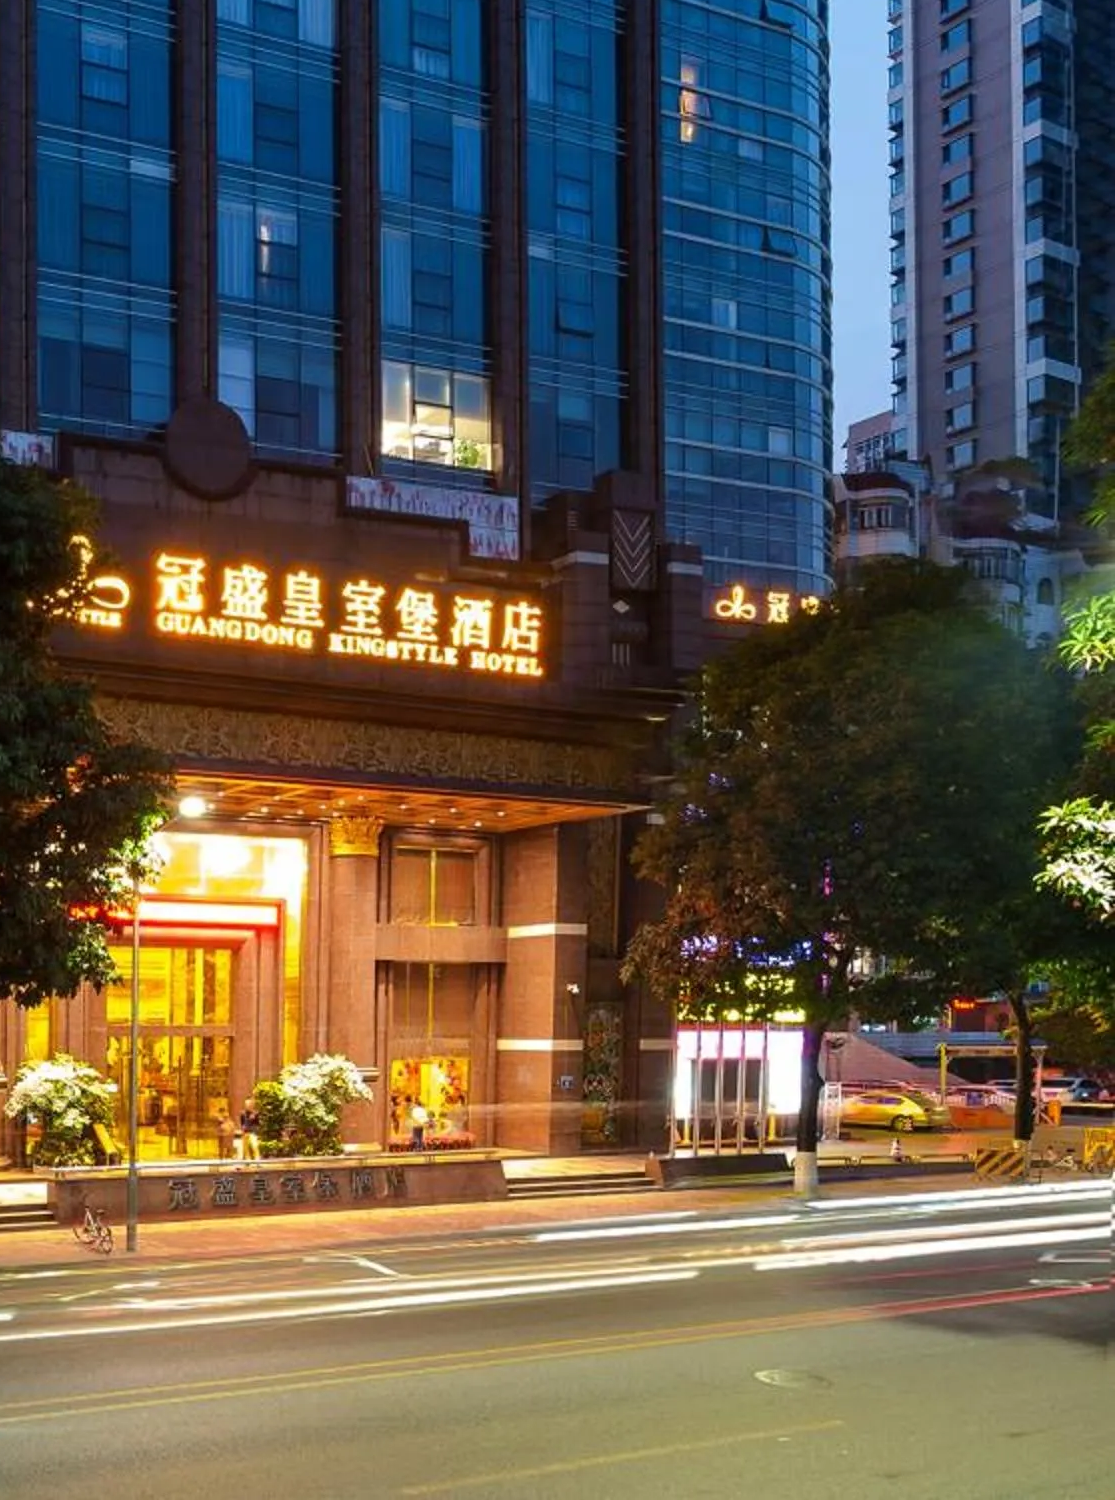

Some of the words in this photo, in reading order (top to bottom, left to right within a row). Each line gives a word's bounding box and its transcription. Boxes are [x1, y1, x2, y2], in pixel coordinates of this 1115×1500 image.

[156, 553, 542, 652] 冠盛皇室堡酒店
[156, 611, 313, 650] GUANGDONG
[329, 632, 459, 666] KINGSTYLE
[470, 650, 544, 677] HOTEL
